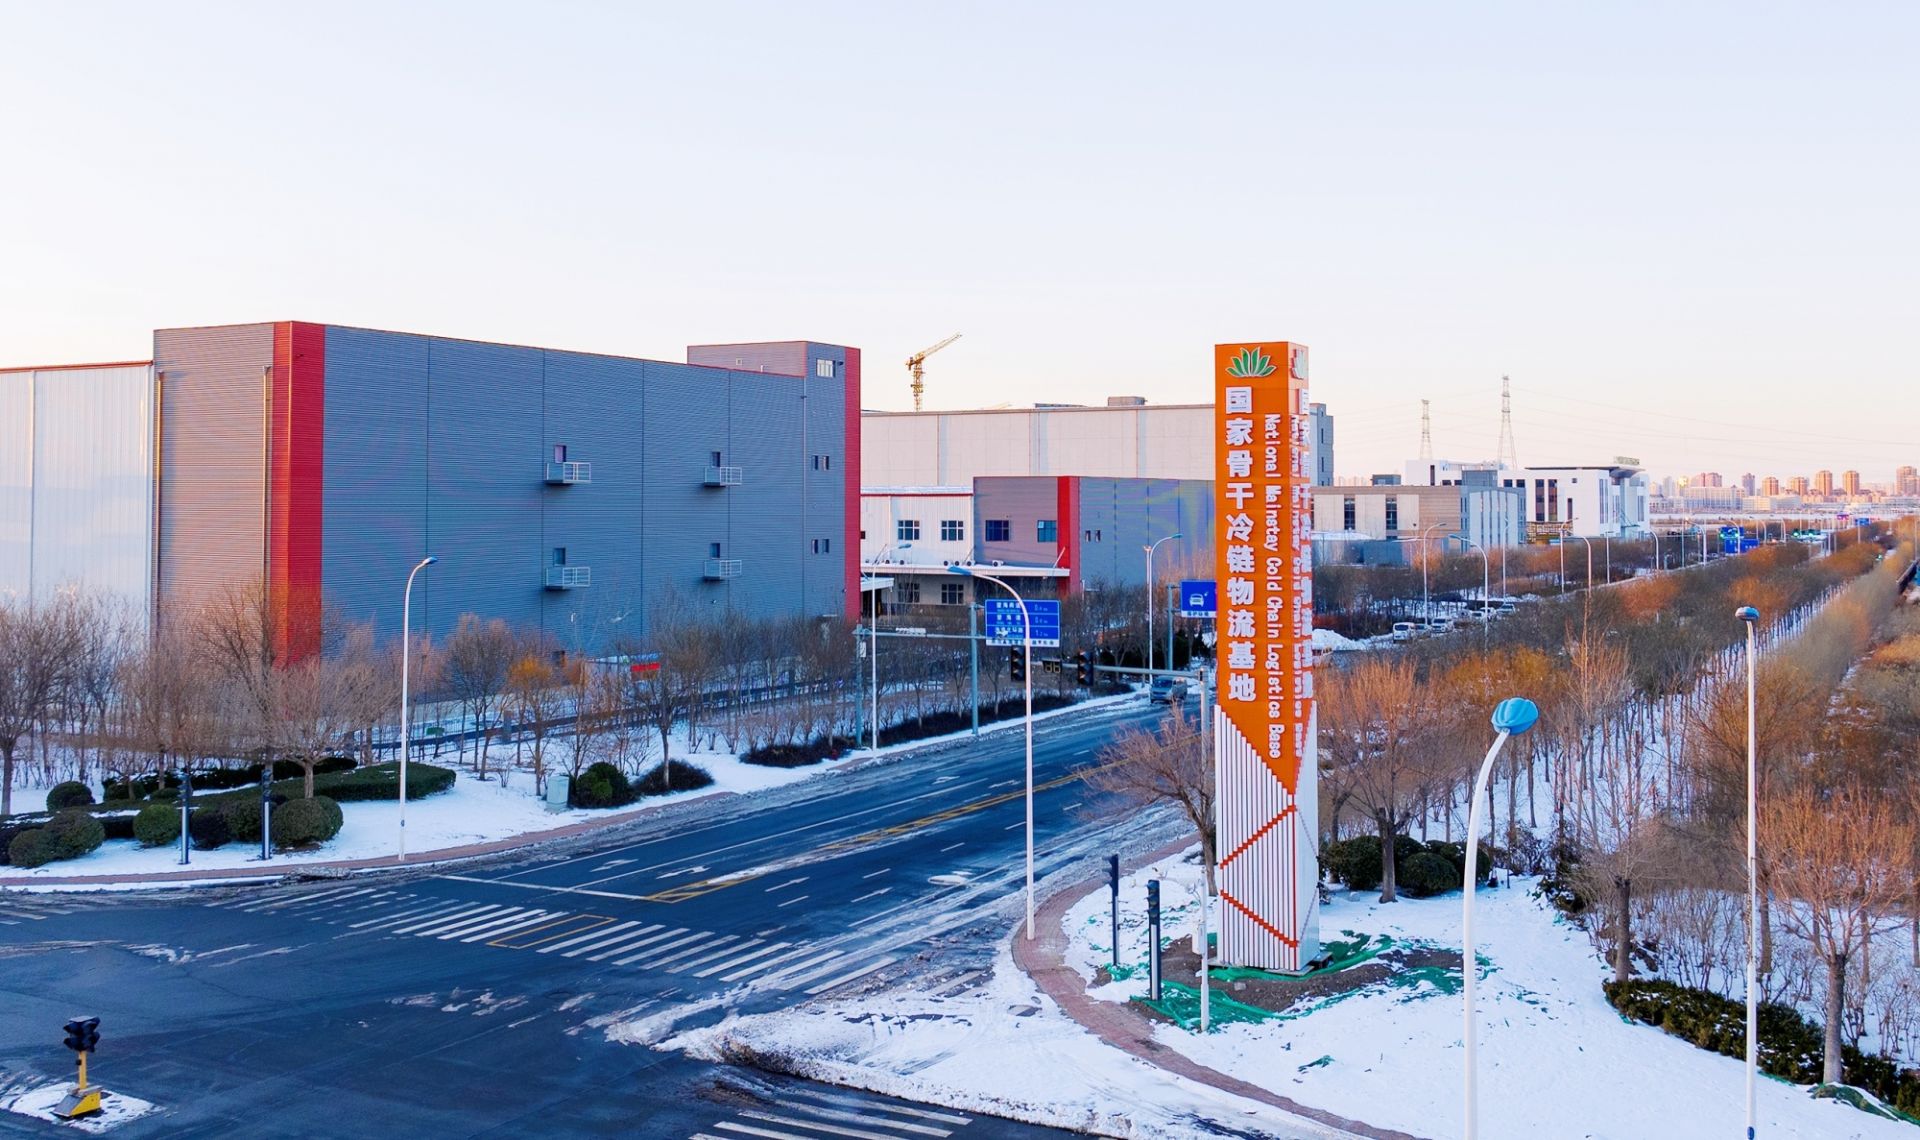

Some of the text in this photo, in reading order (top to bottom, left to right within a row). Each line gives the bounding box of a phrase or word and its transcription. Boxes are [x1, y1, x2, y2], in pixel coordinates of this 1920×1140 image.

[1225, 386, 1256, 702] 国家骨干冷链物流基地
[1264, 414, 1285, 759] National Mainstay Cold Chain Logistics Base
